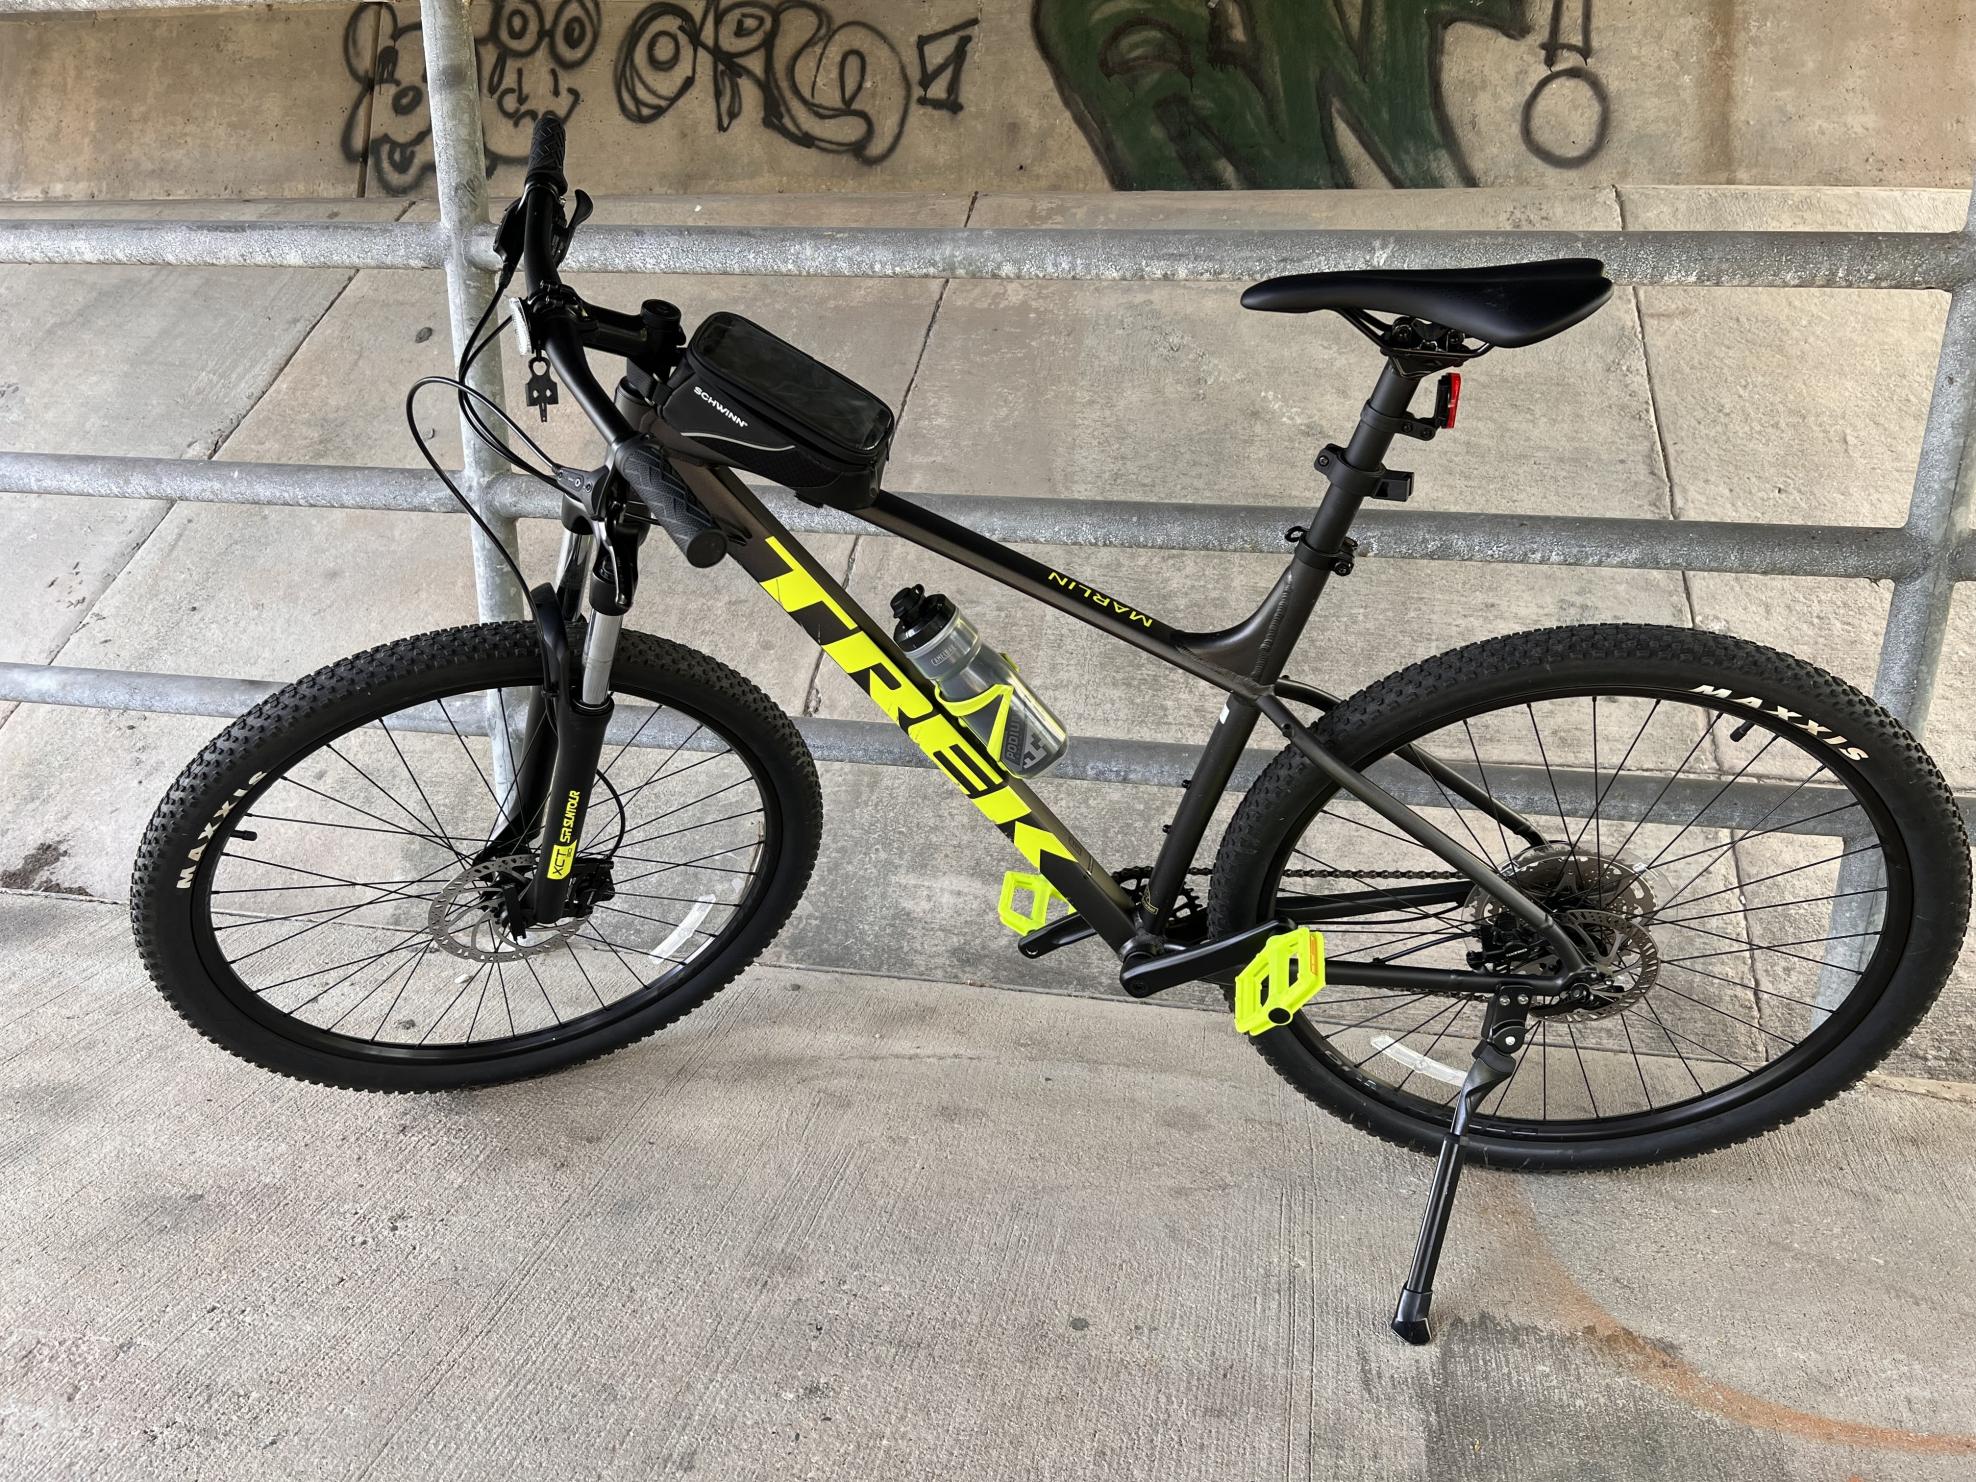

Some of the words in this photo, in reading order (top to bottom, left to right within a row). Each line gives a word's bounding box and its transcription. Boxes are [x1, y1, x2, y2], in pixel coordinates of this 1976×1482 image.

[693, 386, 747, 428] SCHWINN
[1048, 571, 1153, 628] MARLIN
[759, 536, 1078, 869] TREK
[1688, 684, 1869, 761] MAXXIS
[563, 790, 580, 828] SUNTOUR
[552, 848, 567, 876] XCT
